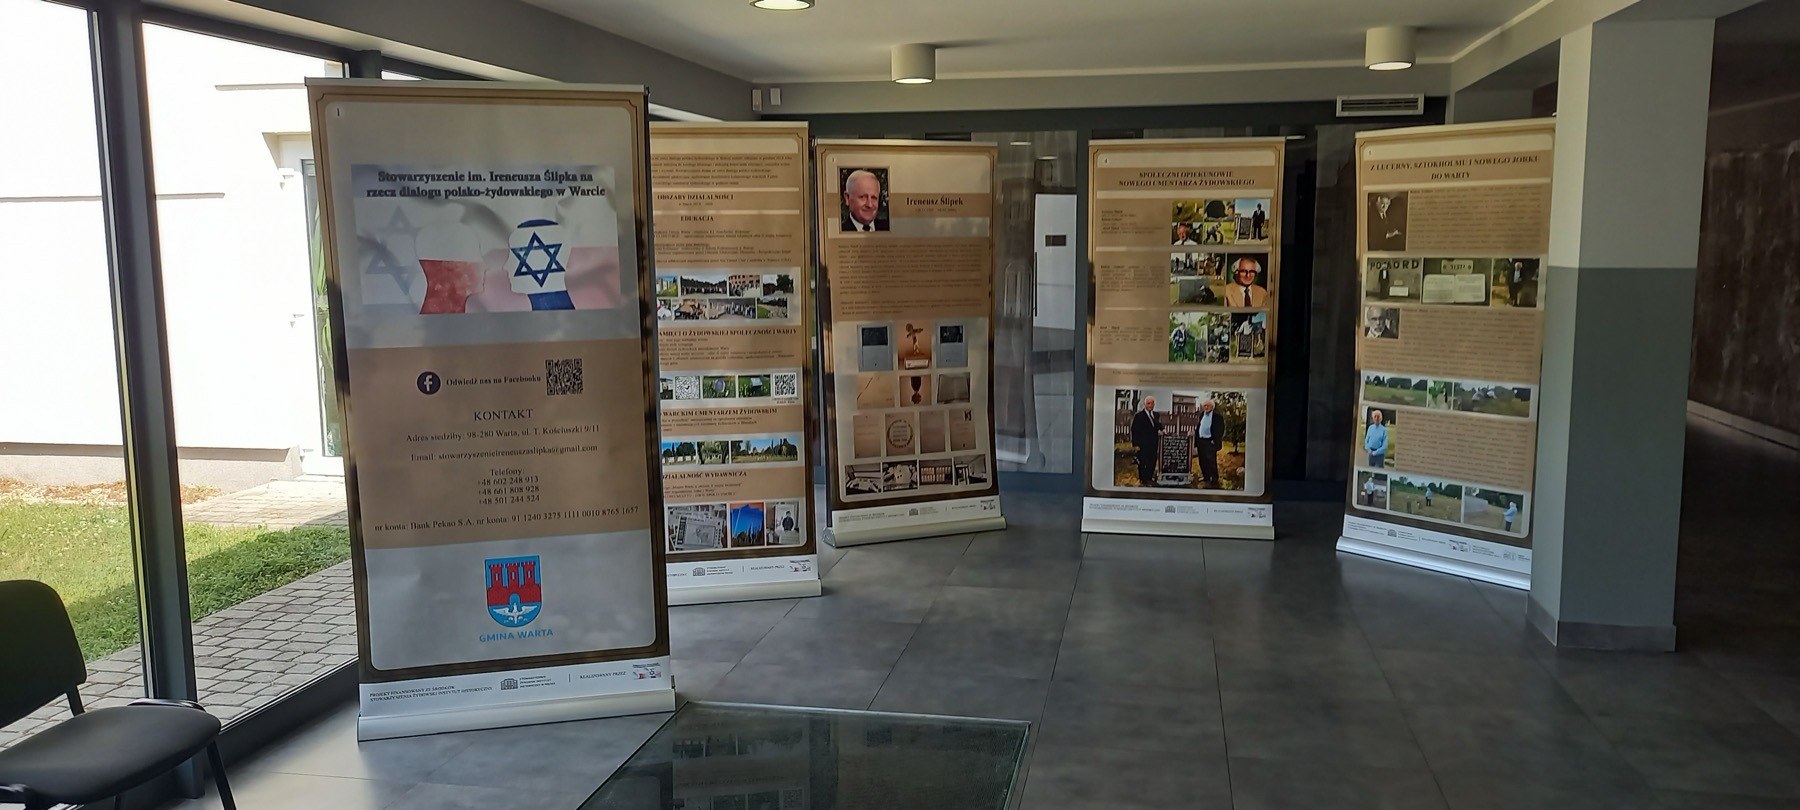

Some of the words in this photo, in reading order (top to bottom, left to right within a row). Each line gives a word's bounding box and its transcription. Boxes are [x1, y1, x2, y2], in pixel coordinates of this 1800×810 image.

[378, 171, 465, 184] Stowarzyszenie
[468, 171, 486, 182] im.
[489, 171, 541, 182] Ireneusza
[543, 169, 578, 184] Ślipka
[580, 173, 593, 182] na
[366, 189, 397, 198] rzecz
[399, 186, 442, 199] dialogu
[444, 186, 553, 199] polsko-żydowskiego
[556, 188, 566, 196] w
[568, 186, 606, 196] Warcie
[906, 197, 938, 206] Ireneusz
[940, 195, 963, 207] Ślipek
[503, 375, 542, 384] Facebooku
[474, 408, 534, 421] KONTAKT
[406, 434, 429, 442] Adres
[467, 430, 494, 439] 98-280
[496, 428, 520, 439] Warta,
[543, 425, 582, 435] Kościuszki
[410, 521, 430, 530] Bank
[433, 519, 456, 529] Pekao
[511, 514, 520, 522] 91
[523, 513, 541, 522] 1240
[544, 512, 562, 520] 3275
[581, 509, 600, 518] 0010
[622, 506, 639, 515] 1657
[479, 632, 515, 643] GMINA
[516, 628, 554, 639] WARTA
